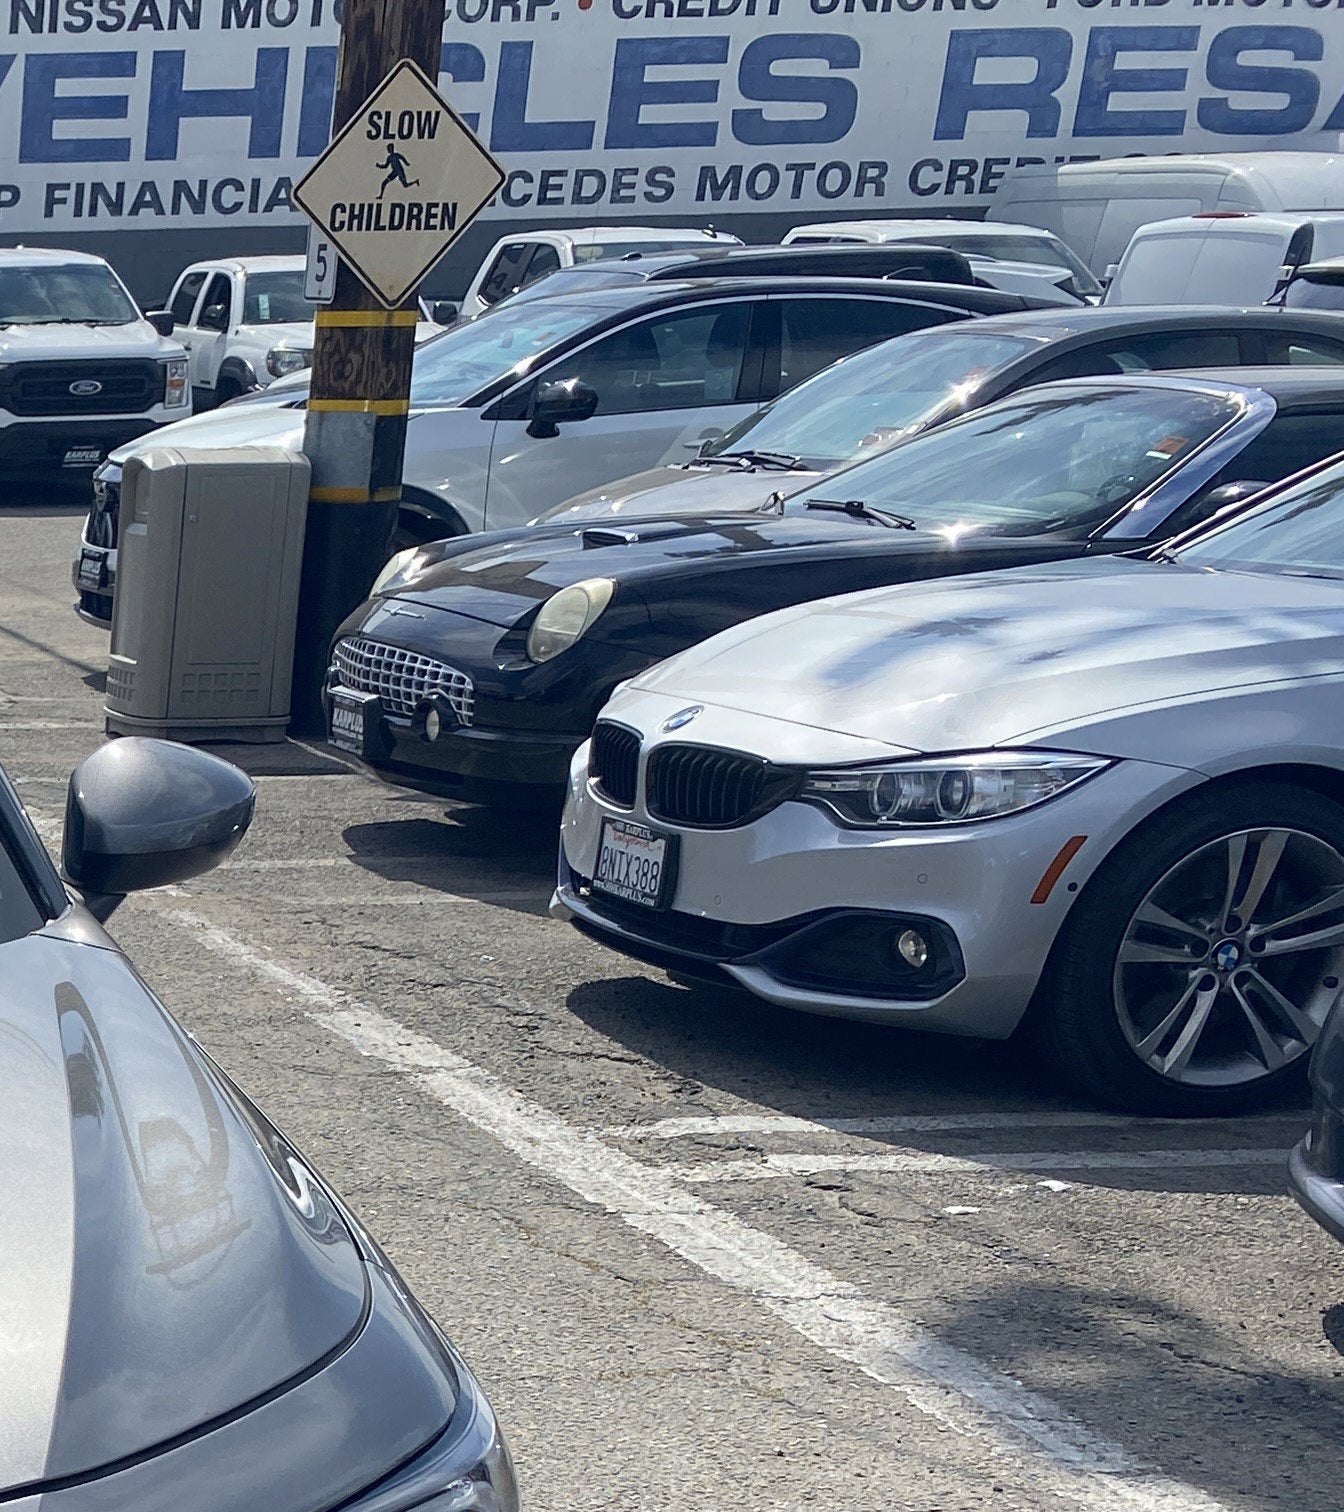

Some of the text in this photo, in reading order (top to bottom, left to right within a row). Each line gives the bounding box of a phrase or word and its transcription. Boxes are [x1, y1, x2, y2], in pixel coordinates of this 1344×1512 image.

[9, 0, 202, 35] NISSAN
[932, 25, 1344, 142] RES
[366, 110, 441, 140] SLOW
[43, 177, 301, 219] FINANCIA
[488, 165, 676, 208] CEDES
[695, 161, 889, 202] MOTOR
[908, 155, 1101, 197] CRE
[329, 202, 458, 232] CHILDREN
[315, 243, 328, 282] 5
